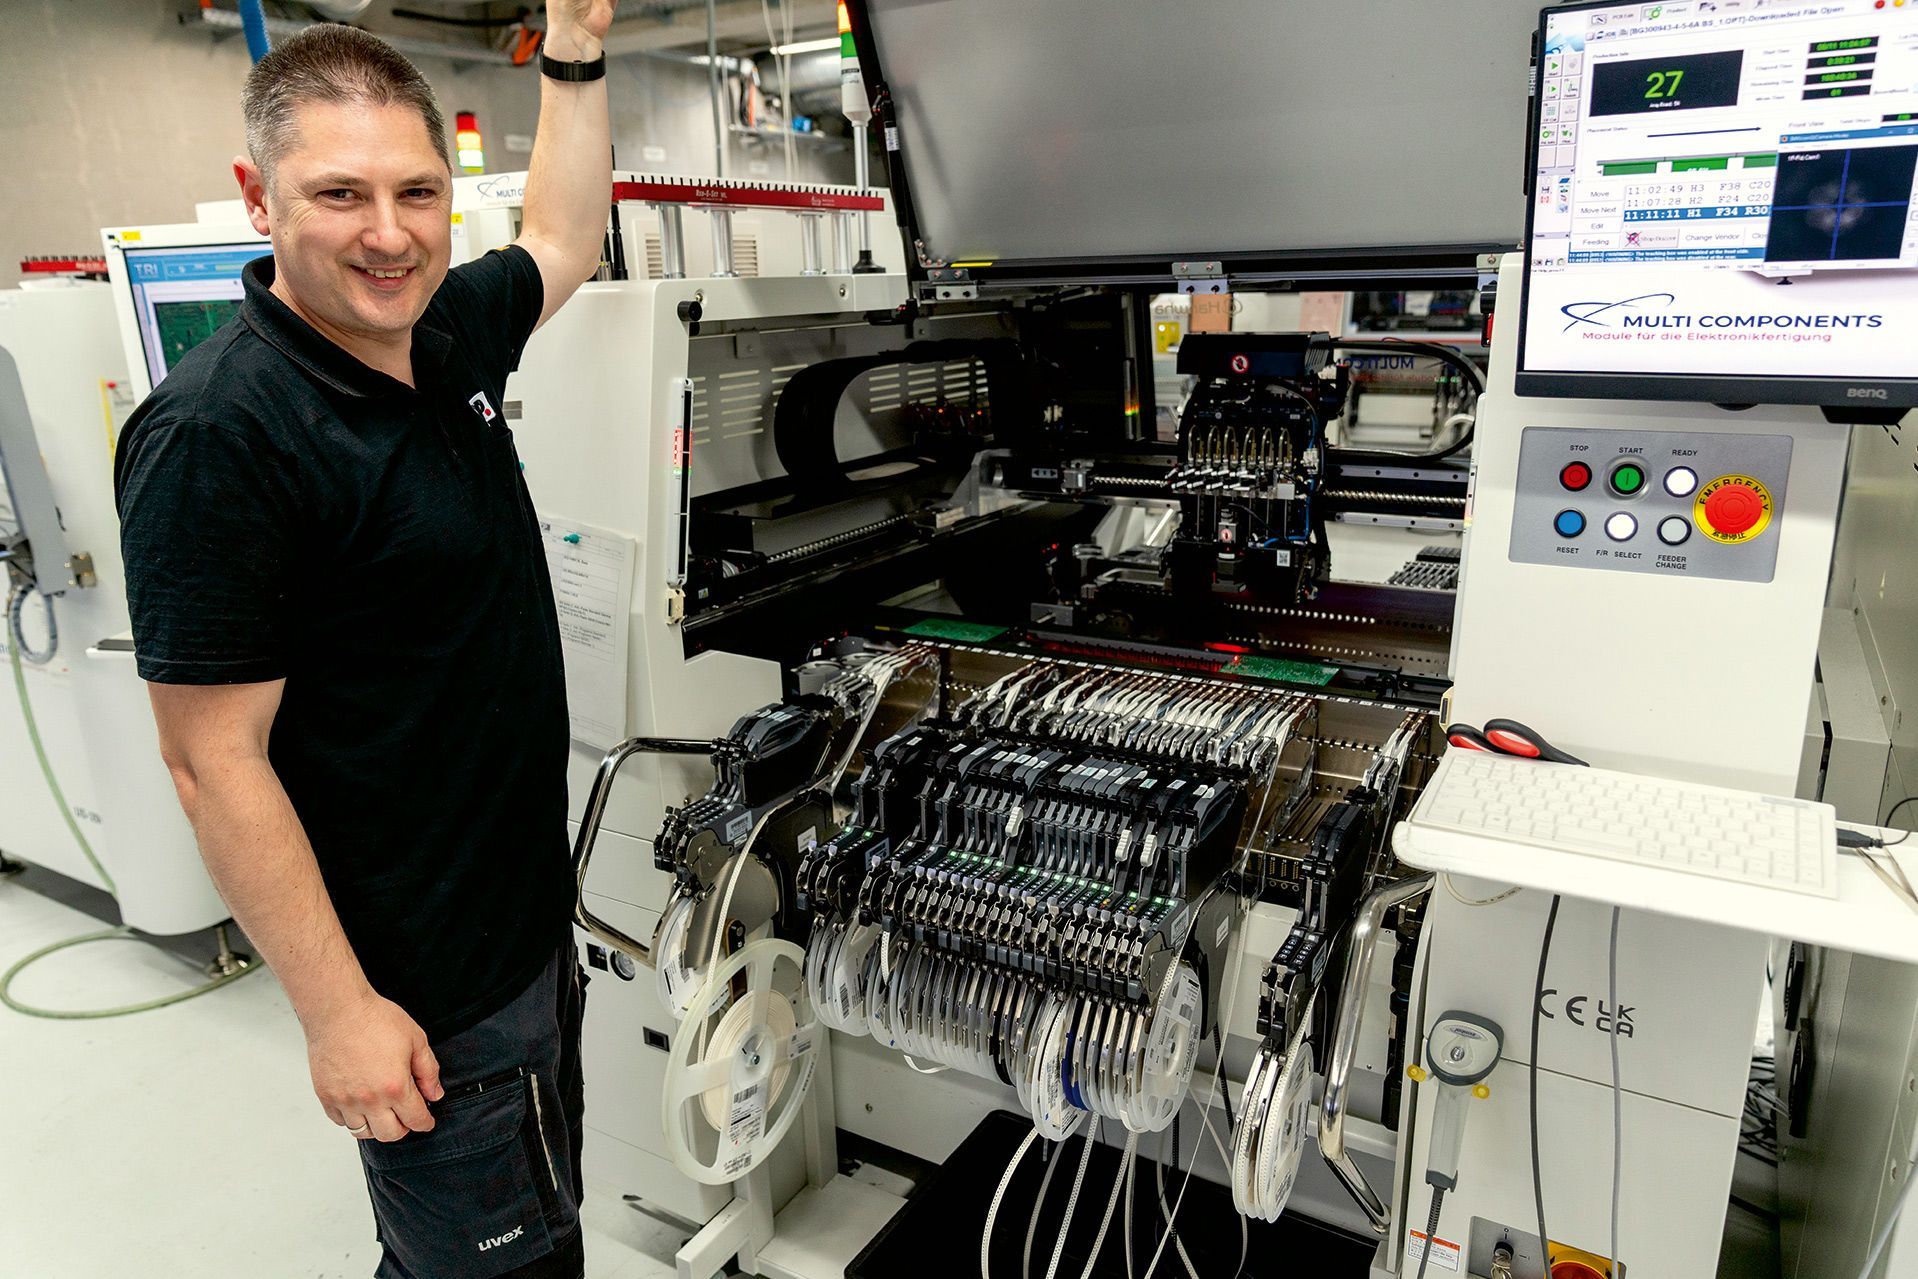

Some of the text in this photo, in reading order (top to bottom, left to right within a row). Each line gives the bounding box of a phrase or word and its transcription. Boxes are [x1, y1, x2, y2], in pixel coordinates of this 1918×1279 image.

[1644, 70, 1684, 98] 27
[496, 188, 516, 198] MULTI
[1628, 186, 1683, 196] 11:02:49
[1690, 184, 1705, 192] H3
[1720, 182, 1742, 191] F38
[1626, 197, 1682, 208] 11:07:28
[1689, 196, 1703, 205] H2
[1718, 194, 1740, 204] F24
[1625, 206, 1768, 220] 11:11:11 H1 F34 R30
[1685, 234, 1712, 242] Change
[134, 263, 158, 275] TRI
[1623, 314, 1884, 328] MULTI COMPONENTS
[1582, 332, 1833, 344] Module für die Elektronikfertigung
[1846, 388, 1888, 400] BenQ
[1699, 478, 1769, 510] EMERGENCY
[1614, 551, 1642, 560] SELECT
[1658, 554, 1687, 563] FEEDER
[1656, 562, 1687, 570] CHANGE
[1539, 989, 1588, 1026] CE
[478, 1225, 524, 1252] uvex
